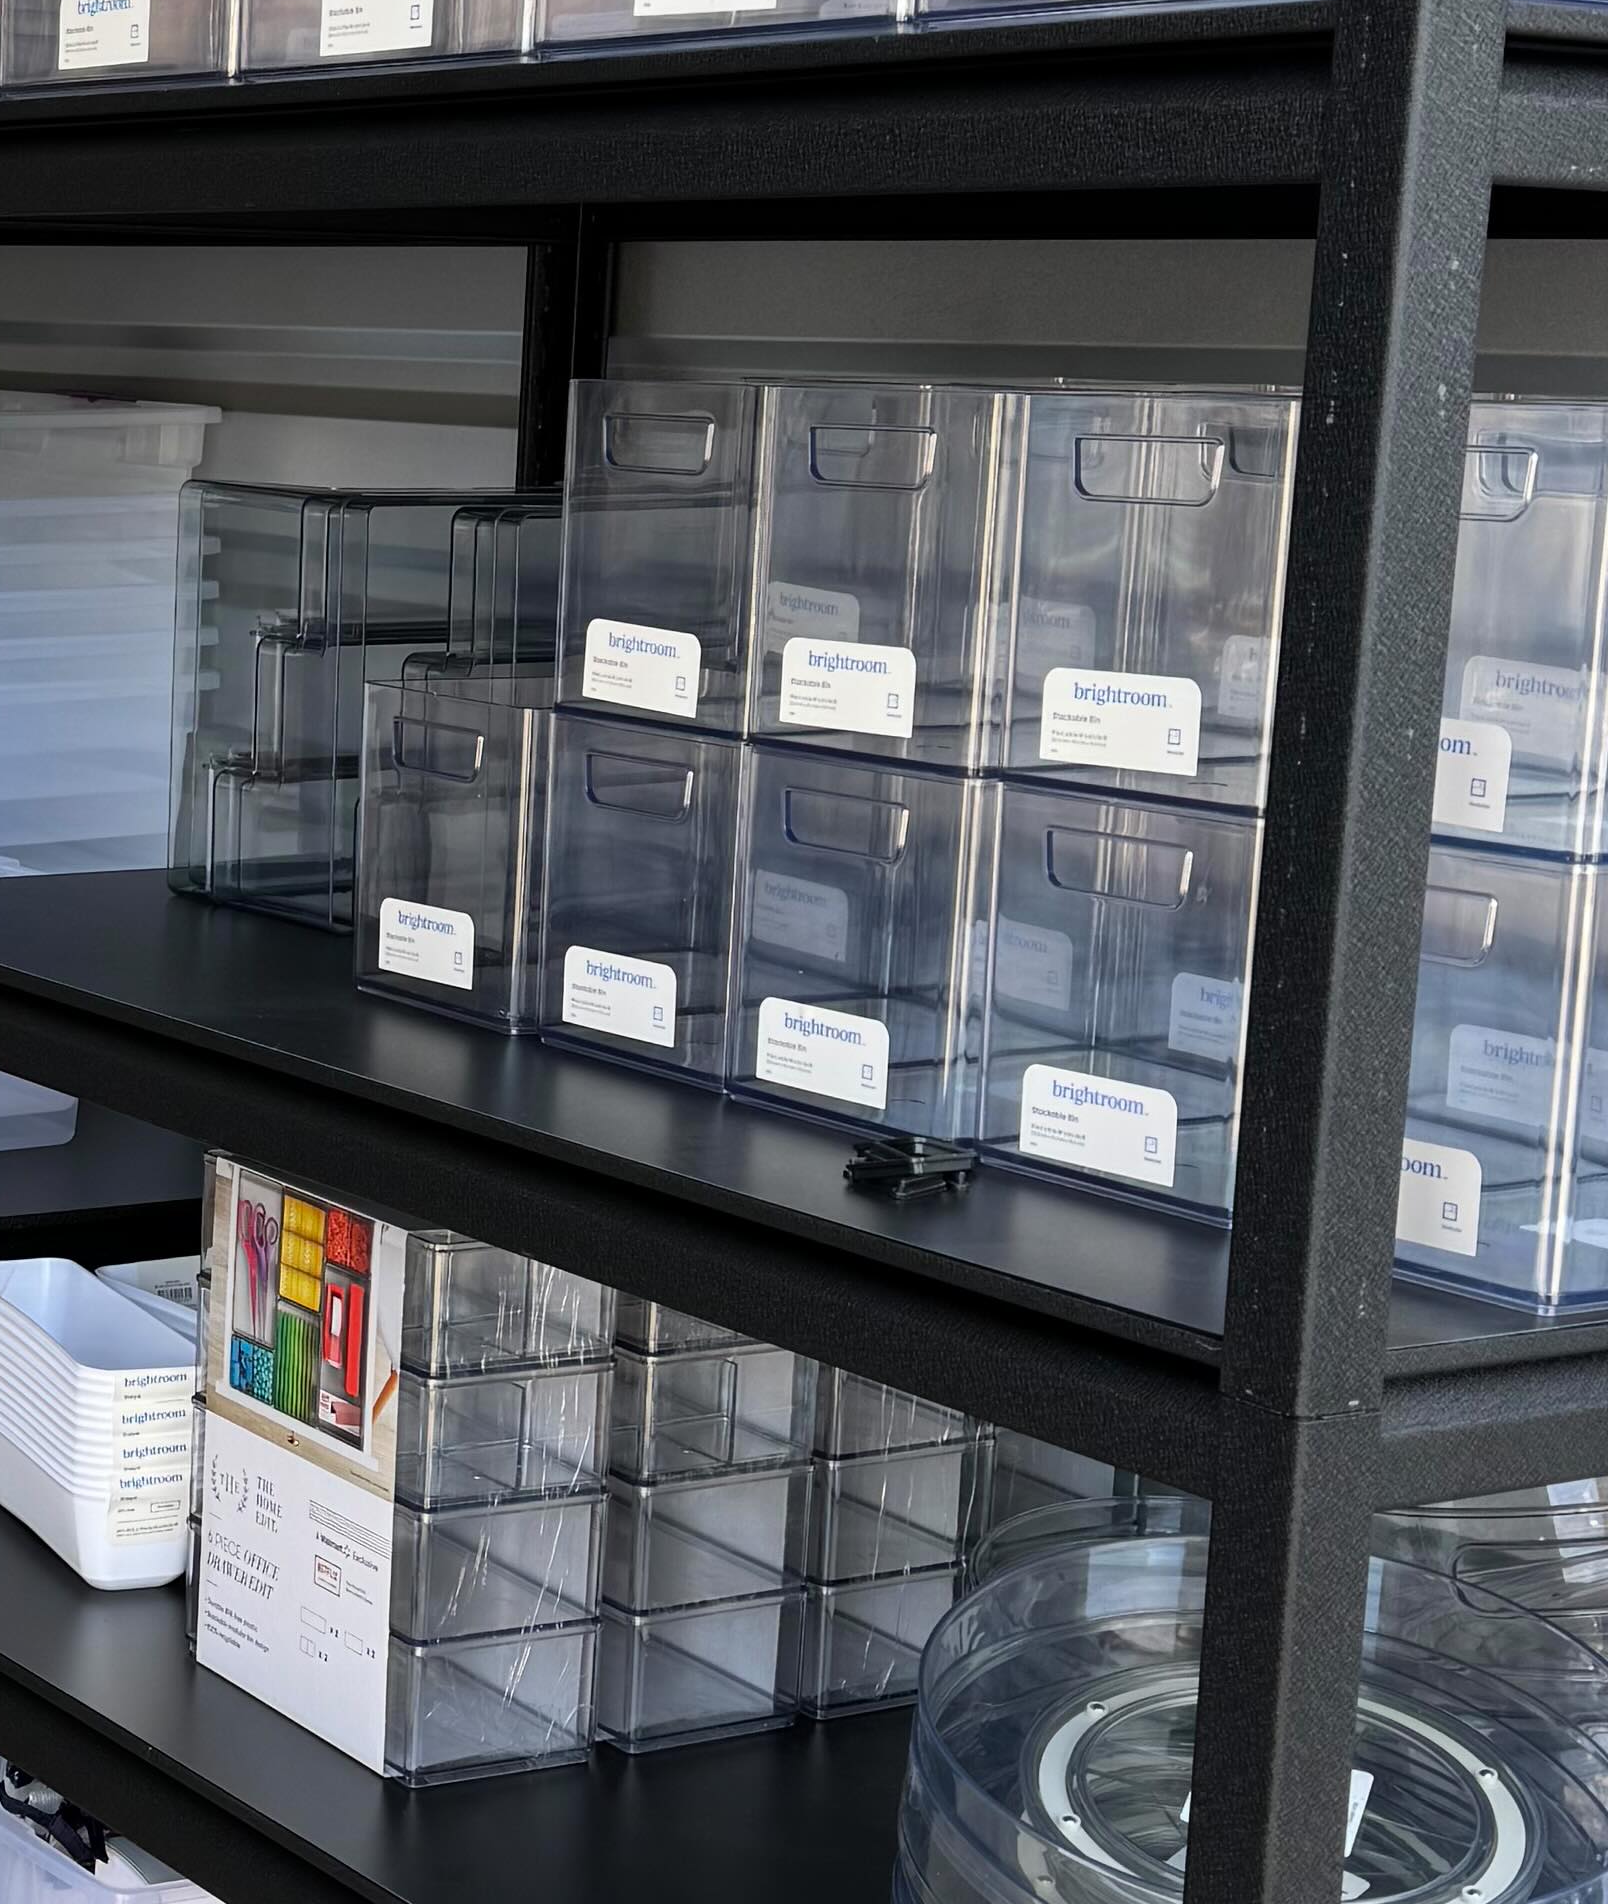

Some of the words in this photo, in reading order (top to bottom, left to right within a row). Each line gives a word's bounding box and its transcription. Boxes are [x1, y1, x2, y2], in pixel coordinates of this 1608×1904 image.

[609, 632, 677, 658] brightroom
[808, 650, 888, 674] brightroom
[1074, 682, 1167, 708] brightroom
[586, 960, 653, 989] brightroom
[784, 1012, 863, 1045] brightroom
[1052, 1080, 1145, 1115] brightroom
[124, 1373, 187, 1387] brightroom
[122, 1408, 186, 1425] brightroom
[120, 1474, 183, 1489] brightroom
[257, 1477, 275, 1497] THE
